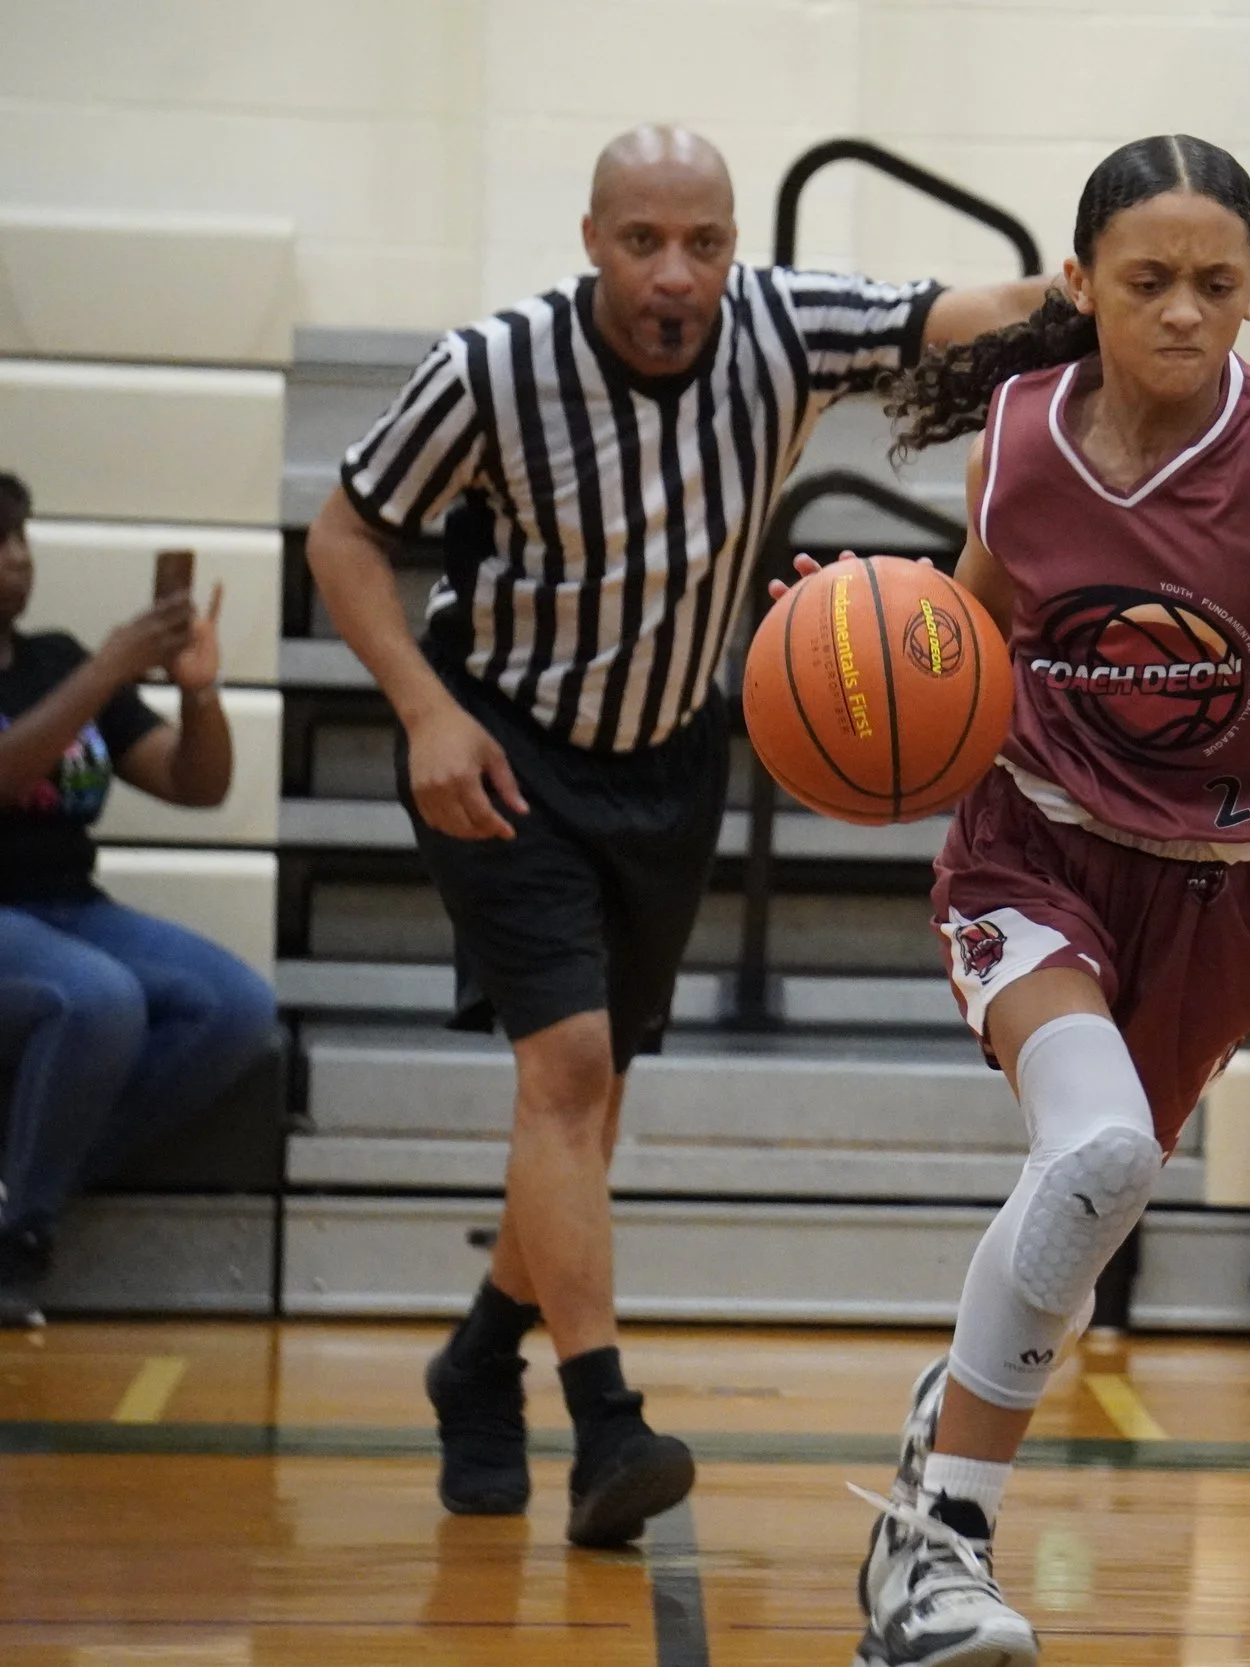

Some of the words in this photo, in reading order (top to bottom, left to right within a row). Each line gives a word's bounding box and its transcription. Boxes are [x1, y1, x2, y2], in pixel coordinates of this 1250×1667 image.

[835, 574, 859, 689] Fundamentals
[848, 692, 873, 739] First
[920, 598, 938, 637] COACH
[929, 636, 942, 675] DEON
[1030, 658, 1137, 695] COACH
[1139, 652, 1242, 693] DEON
[1160, 582, 1194, 599] YOUTH
[1202, 725, 1240, 758] LEAGUE
